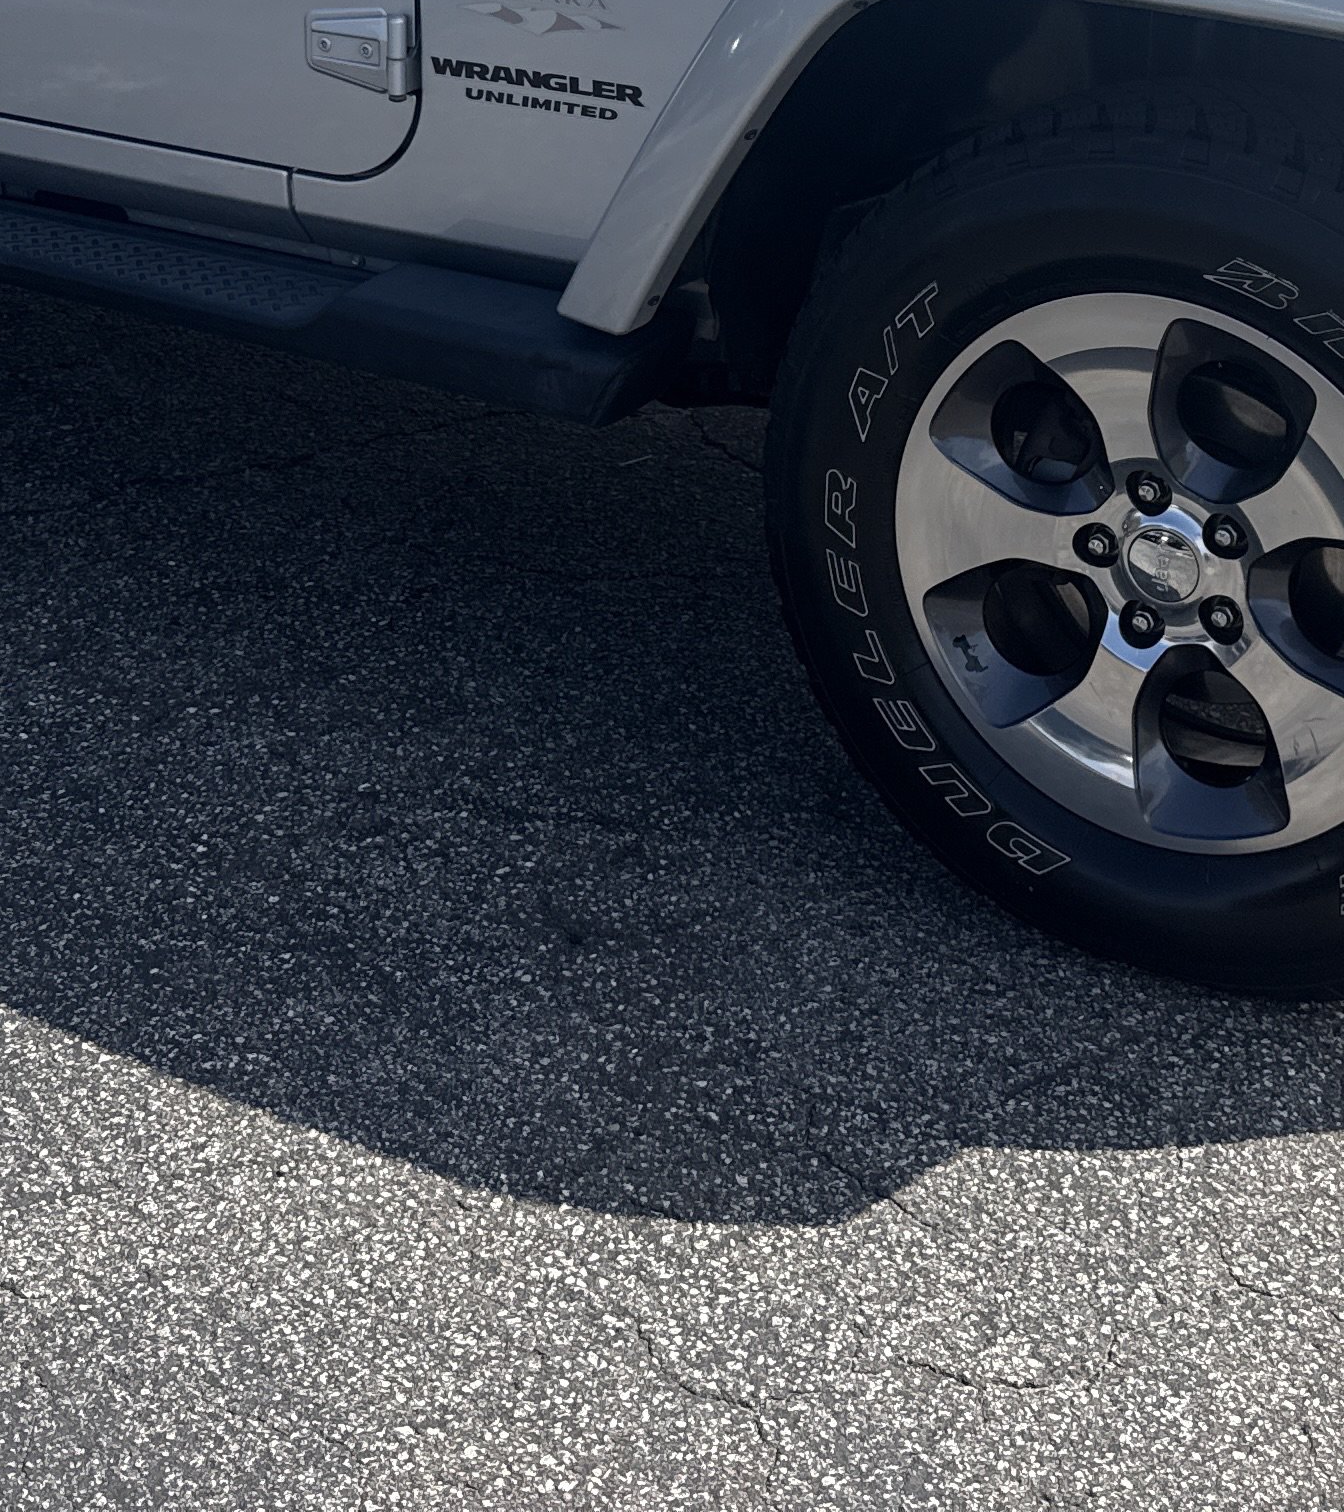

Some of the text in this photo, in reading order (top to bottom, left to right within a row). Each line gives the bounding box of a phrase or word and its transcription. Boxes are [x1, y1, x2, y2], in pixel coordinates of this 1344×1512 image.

[430, 56, 646, 108] WRANGLER
[465, 87, 619, 121] UNLIMITED
[824, 281, 1072, 876] DUELER A/T
